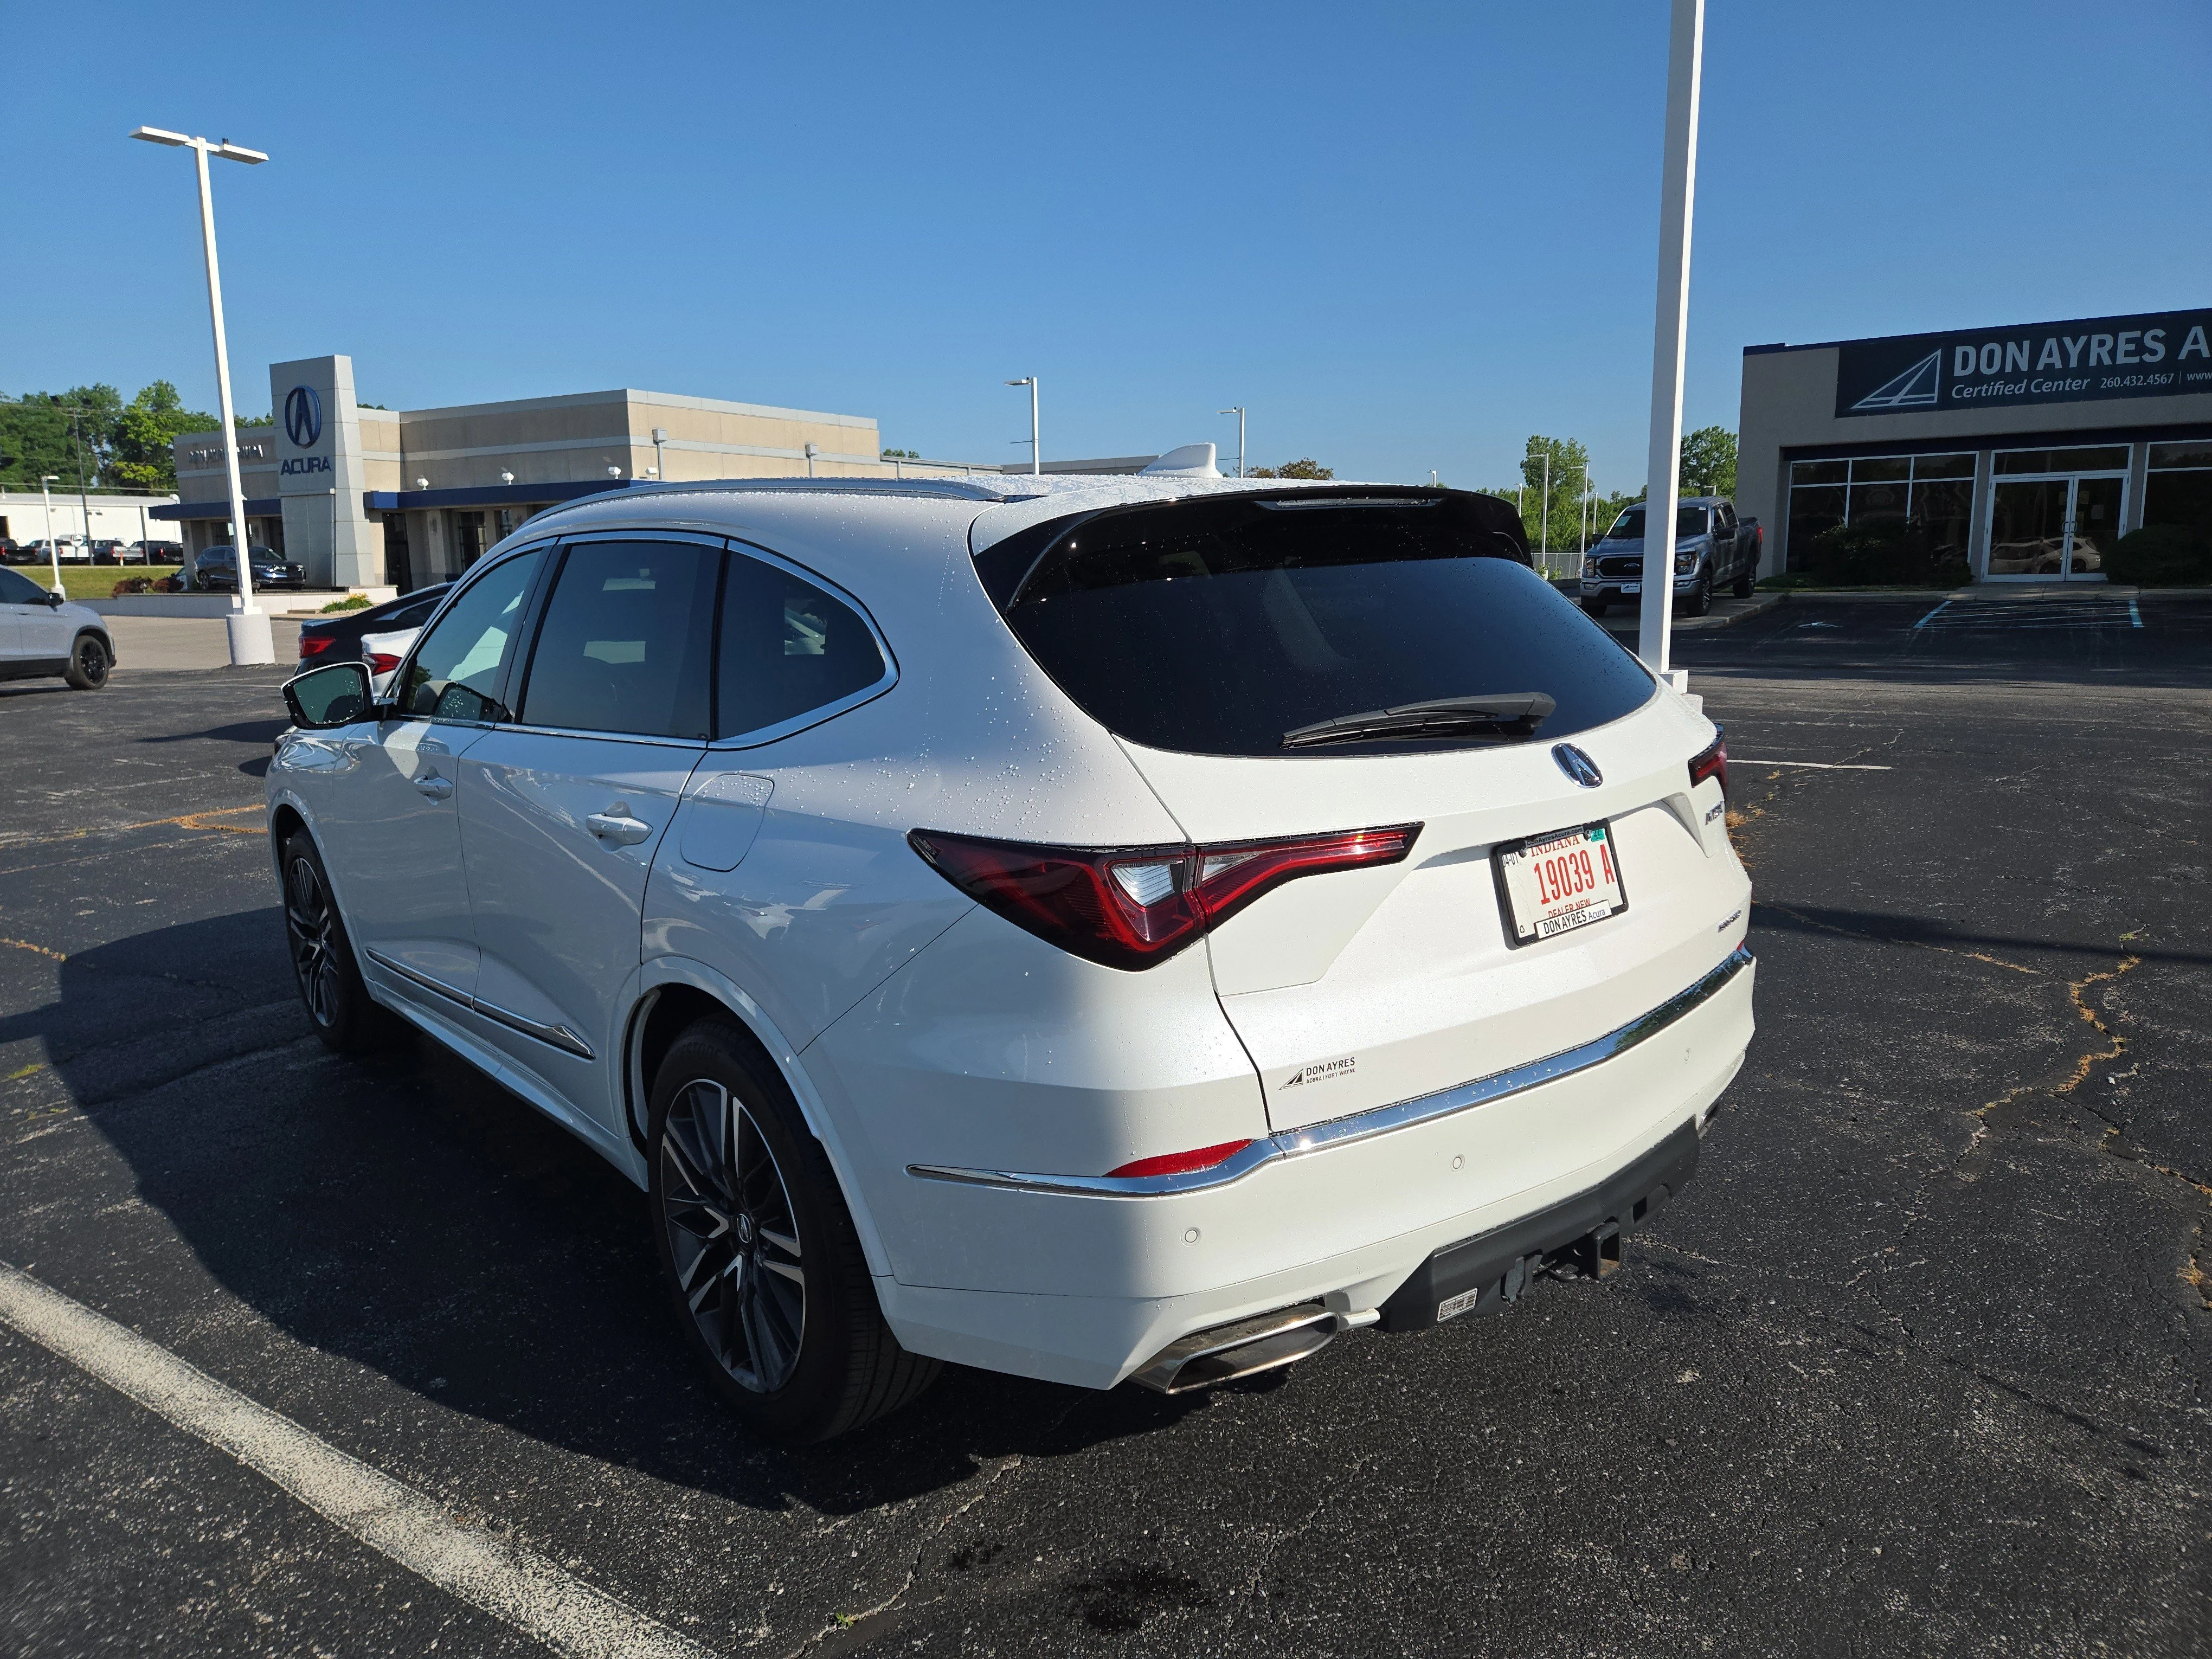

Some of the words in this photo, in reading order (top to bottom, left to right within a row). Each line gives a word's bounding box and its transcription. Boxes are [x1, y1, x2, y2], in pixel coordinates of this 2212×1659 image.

[1953, 340, 2030, 377] DON
[2036, 329, 2166, 370] AYRES
[2177, 325, 2211, 360] A
[1952, 379, 2028, 398] Certified
[2030, 377, 2091, 394] Center
[2100, 372, 2174, 388] 260.432.4567
[280, 456, 332, 475] ACURA
[1531, 835, 1580, 857] INDIANA
[1534, 850, 1594, 905] 19039
[1599, 844, 1615, 884] A
[1548, 903, 1574, 918] DEALER
[1576, 898, 1591, 909] NEW
[1543, 918, 1561, 935] DON
[1561, 910, 1587, 929] AYRES
[1589, 909, 1606, 921] Acura
[1306, 1064, 1324, 1076] DON
[1326, 1057, 1355, 1072] AYRES
